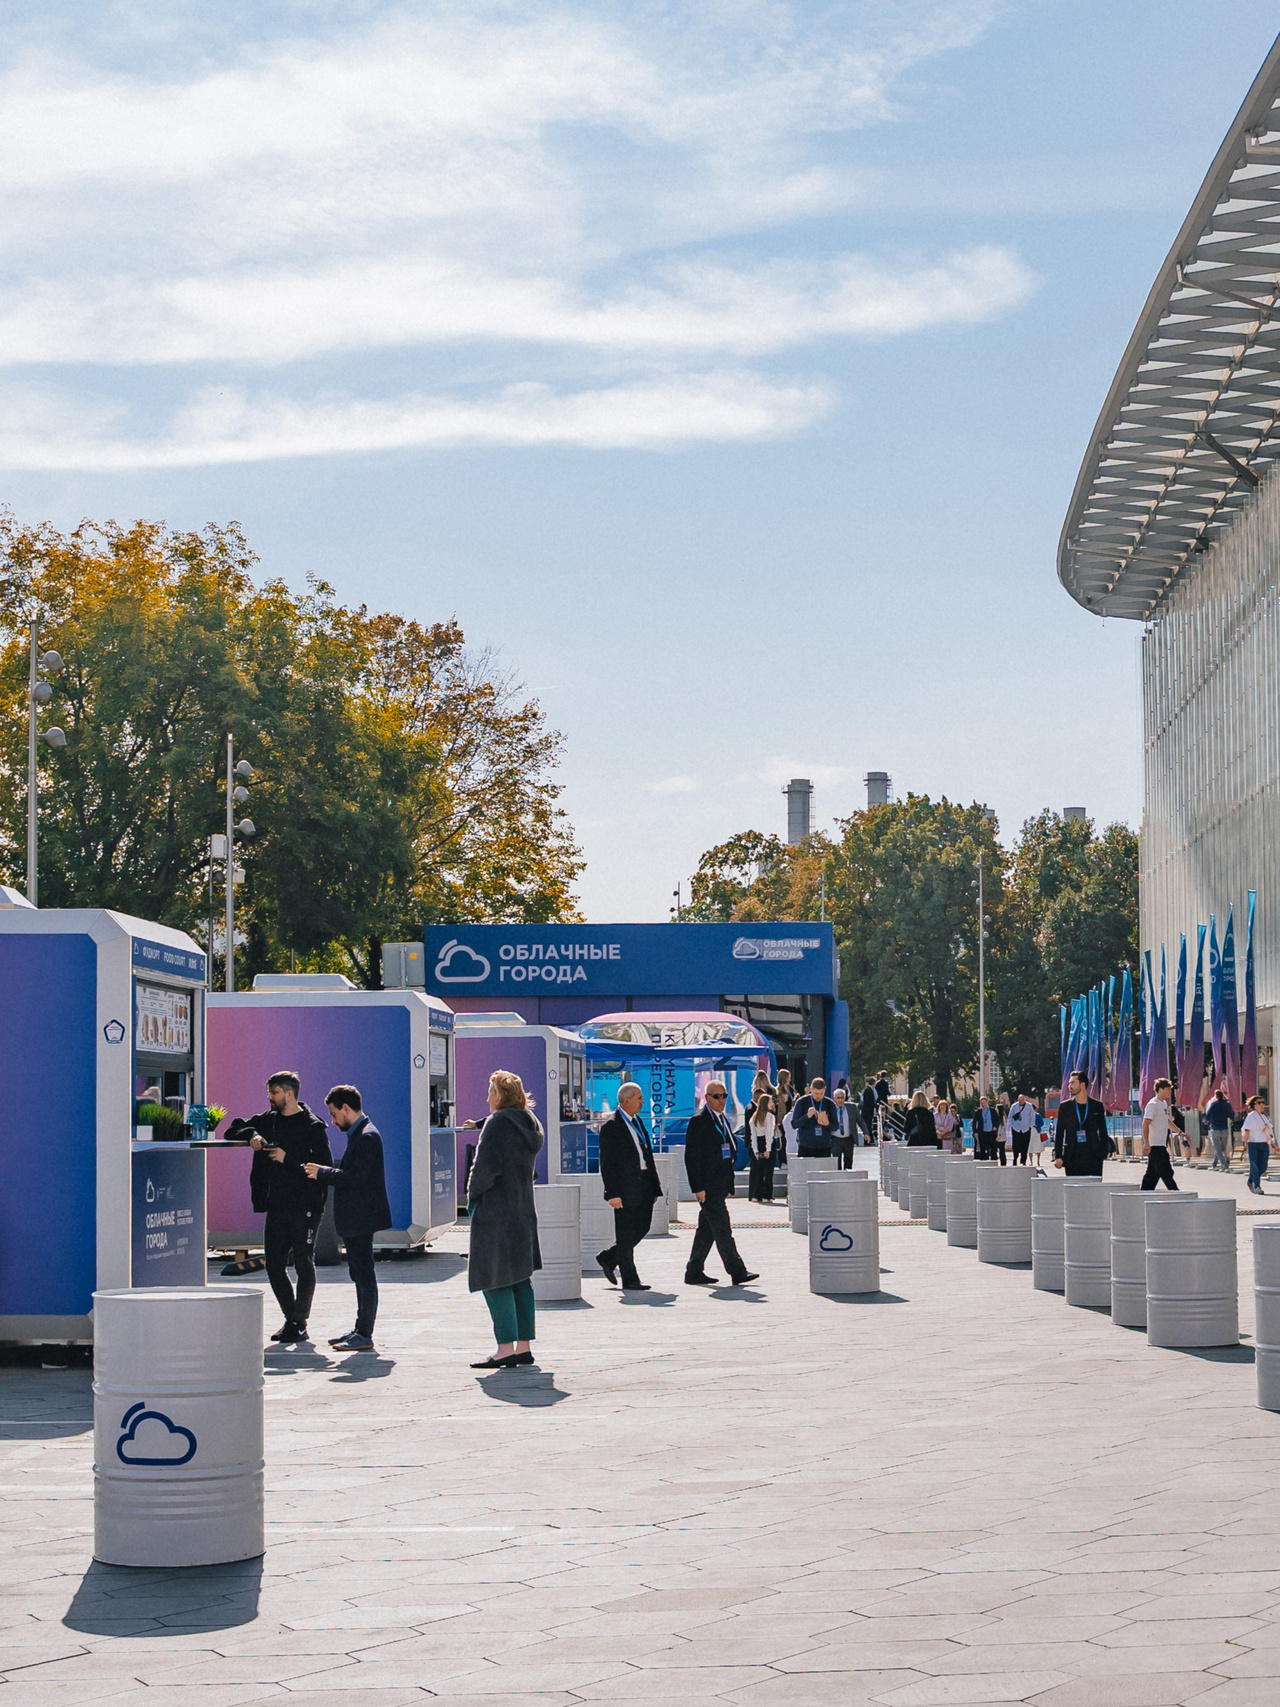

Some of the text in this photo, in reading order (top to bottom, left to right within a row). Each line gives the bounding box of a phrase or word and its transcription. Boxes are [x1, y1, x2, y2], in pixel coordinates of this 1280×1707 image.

[499, 943, 621, 961] ОБЛАЧНЫЕ
[762, 940, 820, 949] ОБЛАЧНЫЕ
[762, 950, 804, 960] ГОРОДА
[499, 965, 588, 984] ГОРОДА
[664, 1034, 676, 1110] КМНАТА
